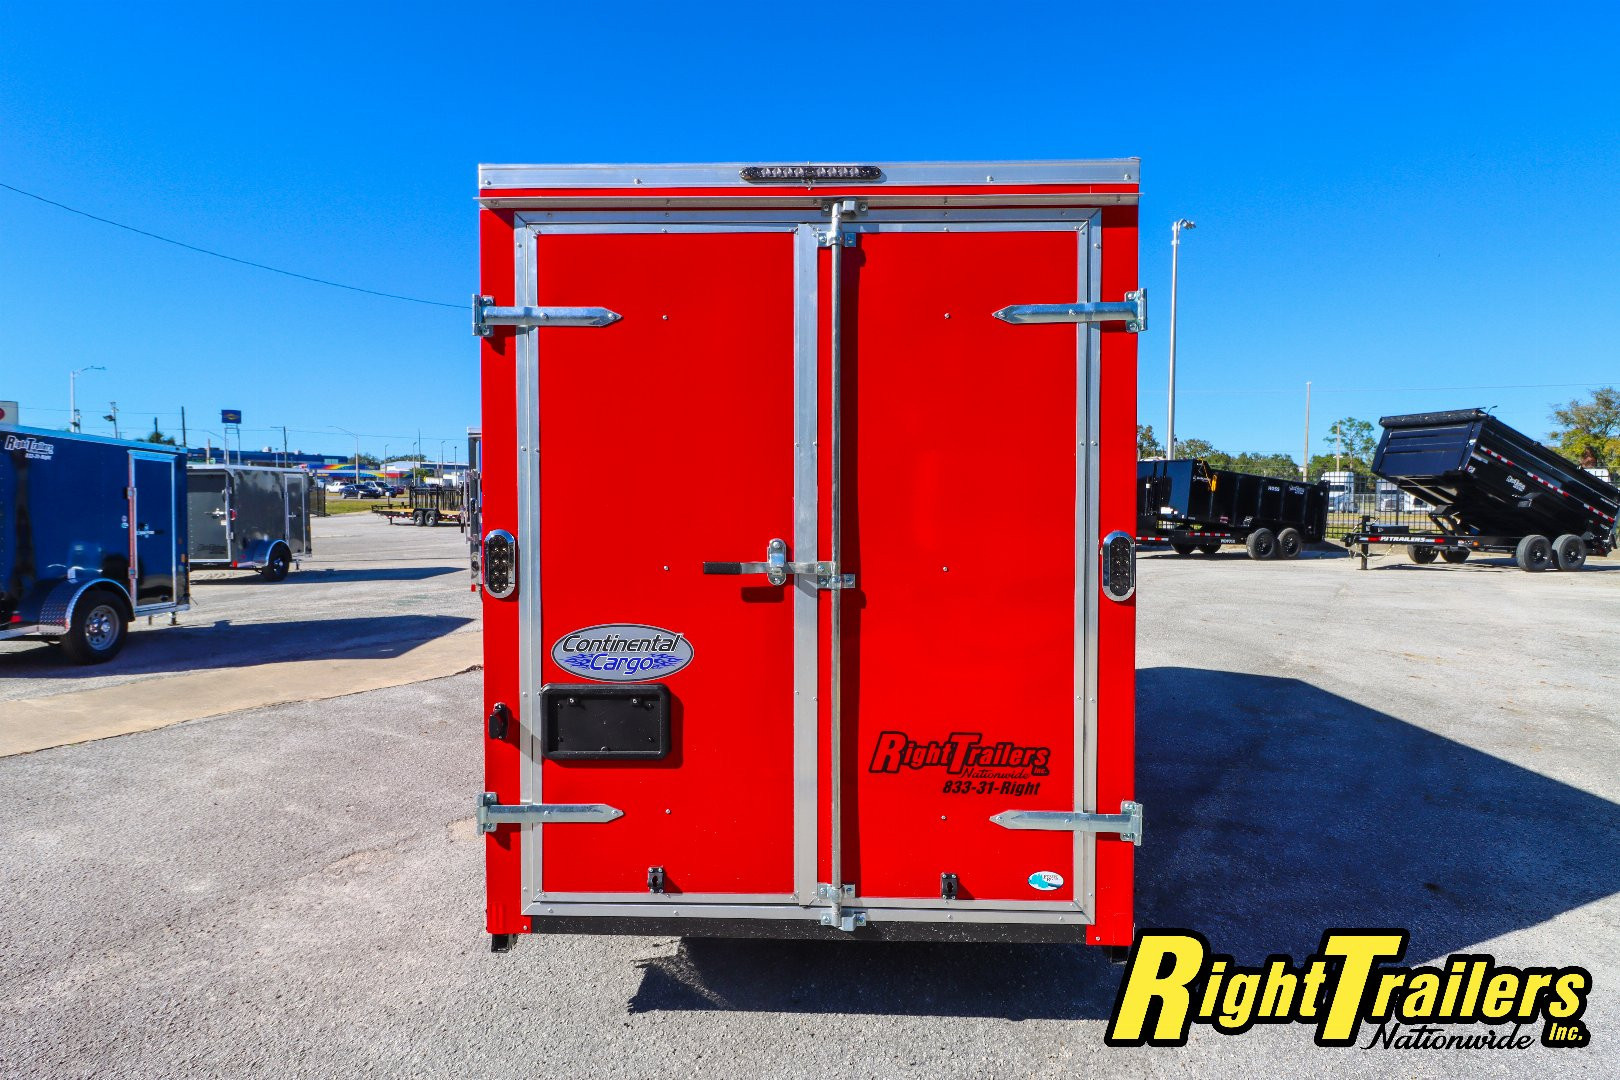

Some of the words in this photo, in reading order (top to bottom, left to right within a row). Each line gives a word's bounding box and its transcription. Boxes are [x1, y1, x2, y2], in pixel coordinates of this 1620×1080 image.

[562, 633, 682, 652] Continental
[590, 653, 655, 675] Cargo
[960, 768, 1030, 779] Nationwide
[942, 780, 1041, 796] 833-31-Right
